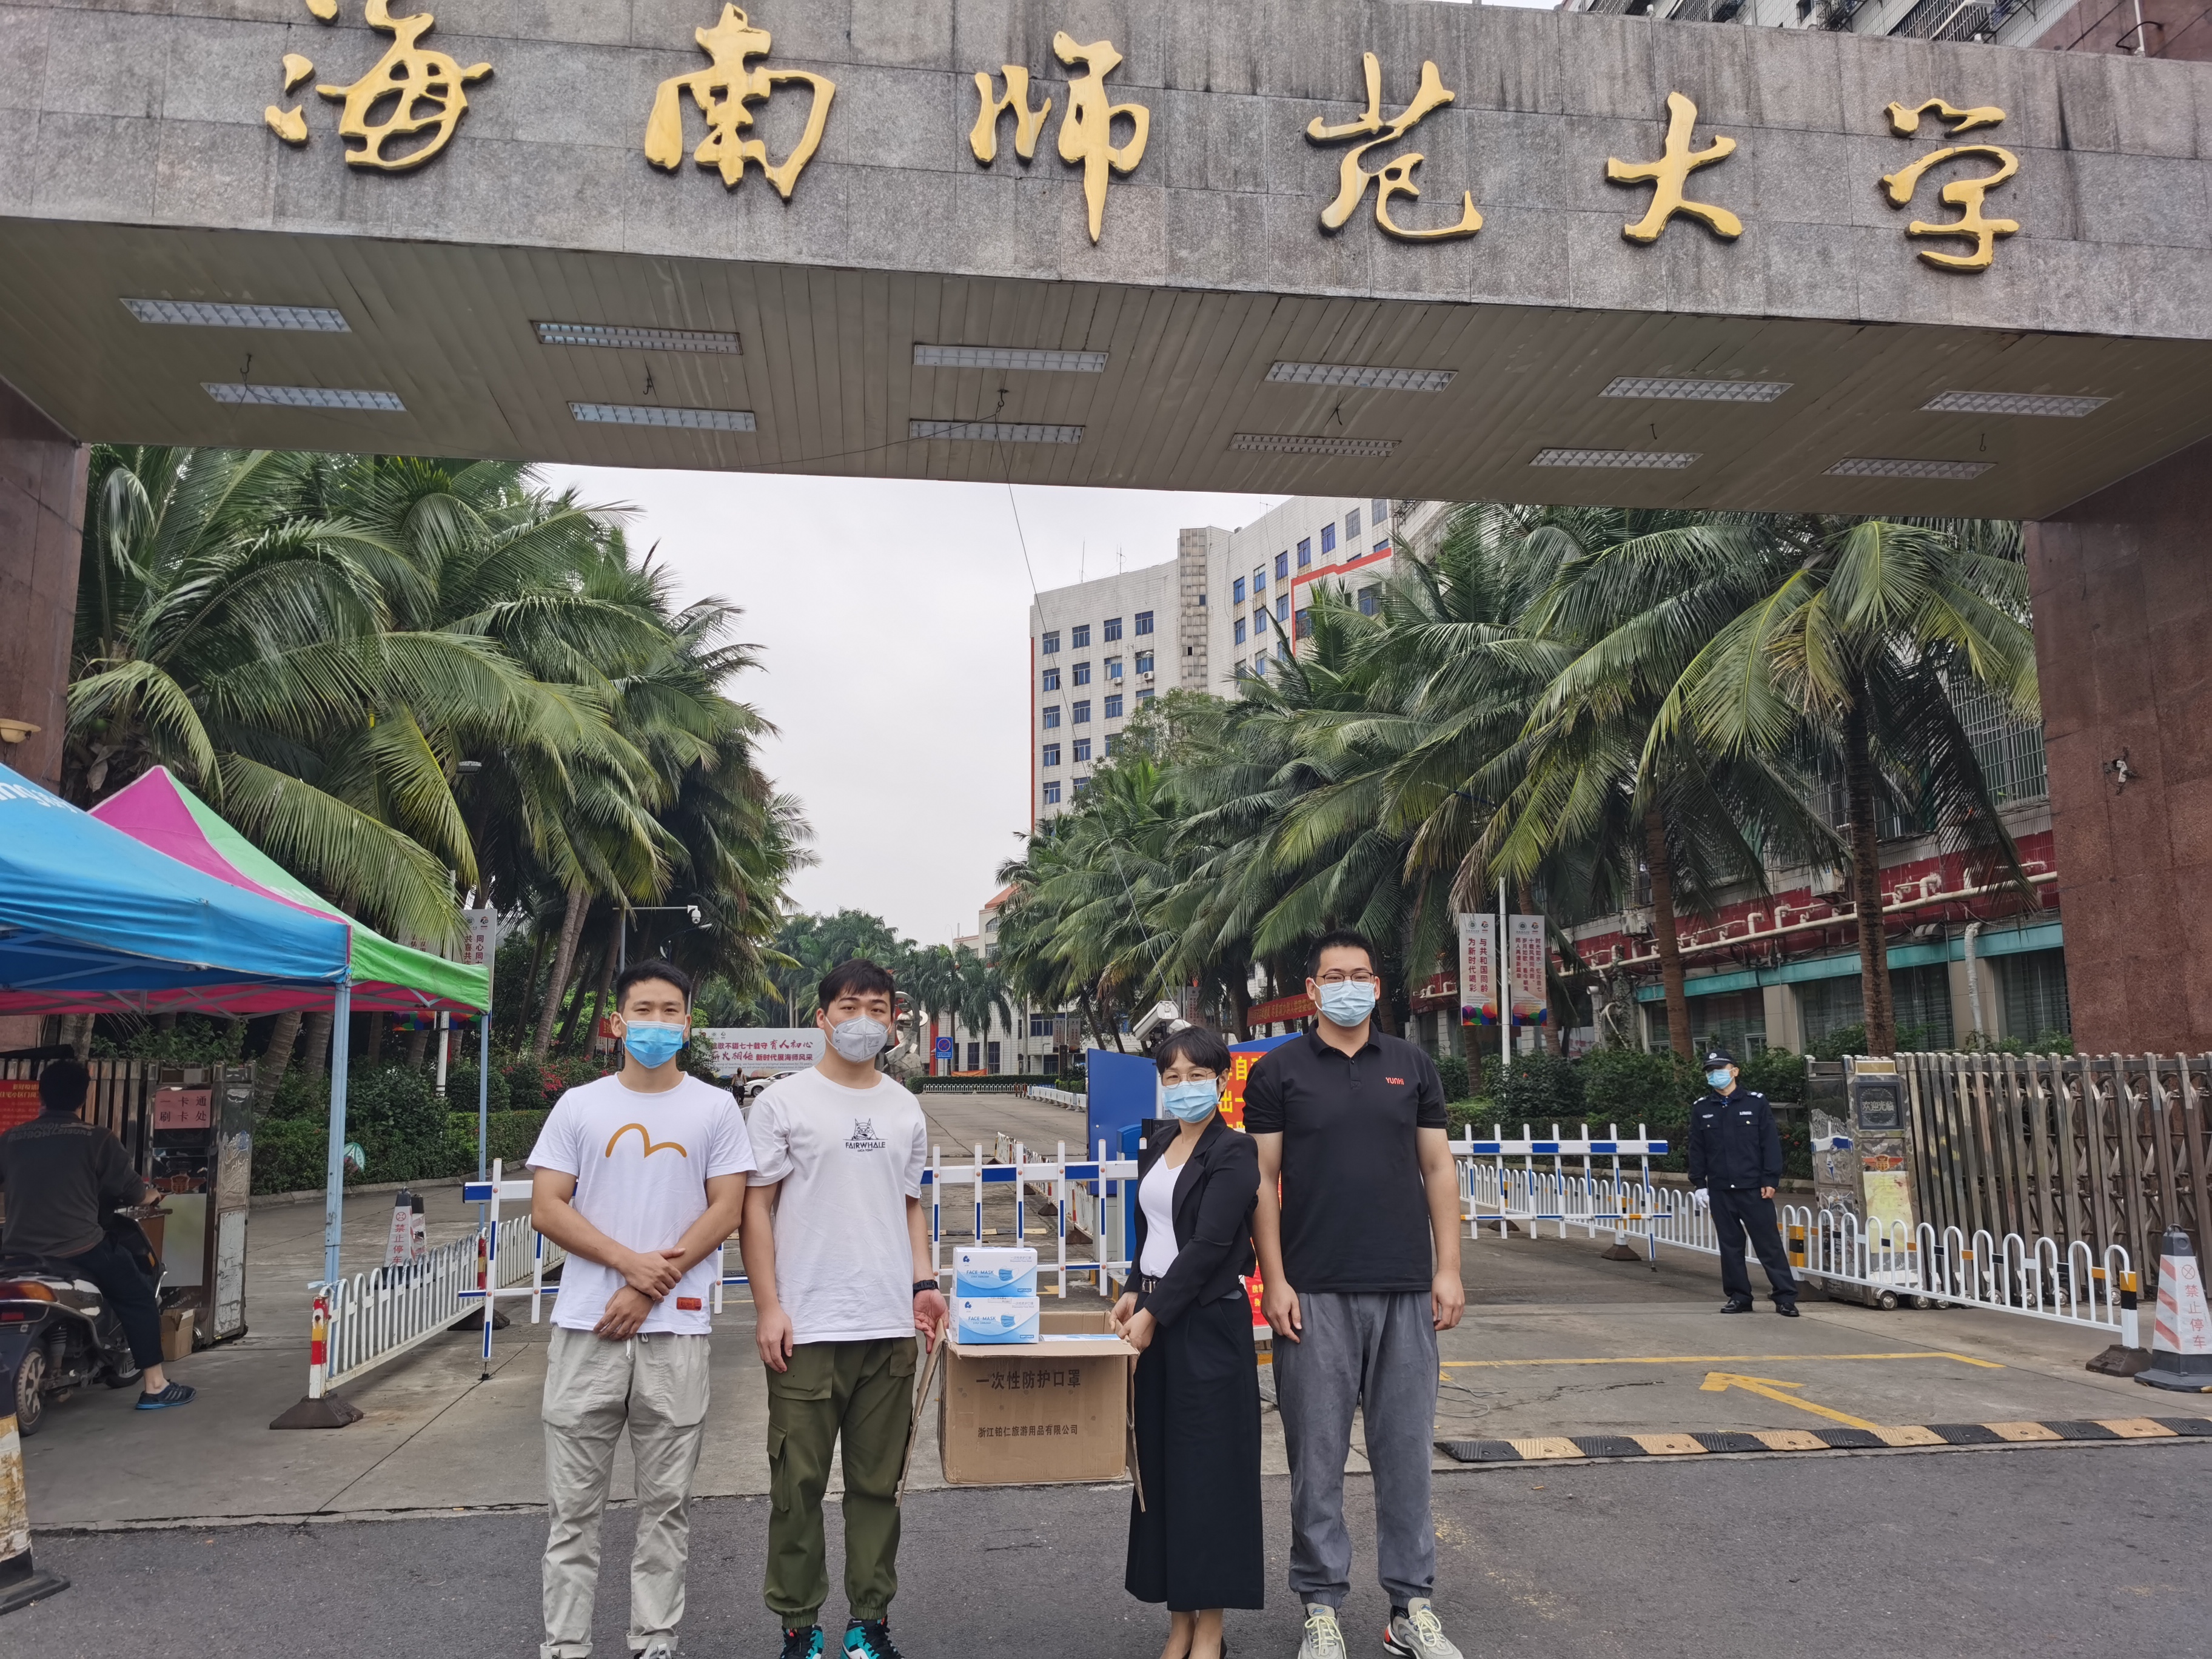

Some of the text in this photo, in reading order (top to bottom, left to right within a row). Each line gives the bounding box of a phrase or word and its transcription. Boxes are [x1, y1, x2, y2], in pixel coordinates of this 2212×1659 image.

[1468, 938, 1477, 993] 为新时代喝彩
[1480, 938, 1488, 993] 与共和国同龄
[160, 1096, 207, 1107] 一卡通
[1862, 1101, 1894, 1112] 欢迎光临
[159, 1110, 207, 1122] 刷卡处
[392, 1224, 407, 1264] 禁止停车
[2185, 1284, 2207, 1349] 禁止停车
[976, 1369, 1081, 1390] 一次性防护口罩
[978, 1424, 1078, 1438] 浙江铂仁旅游用品有限公司
